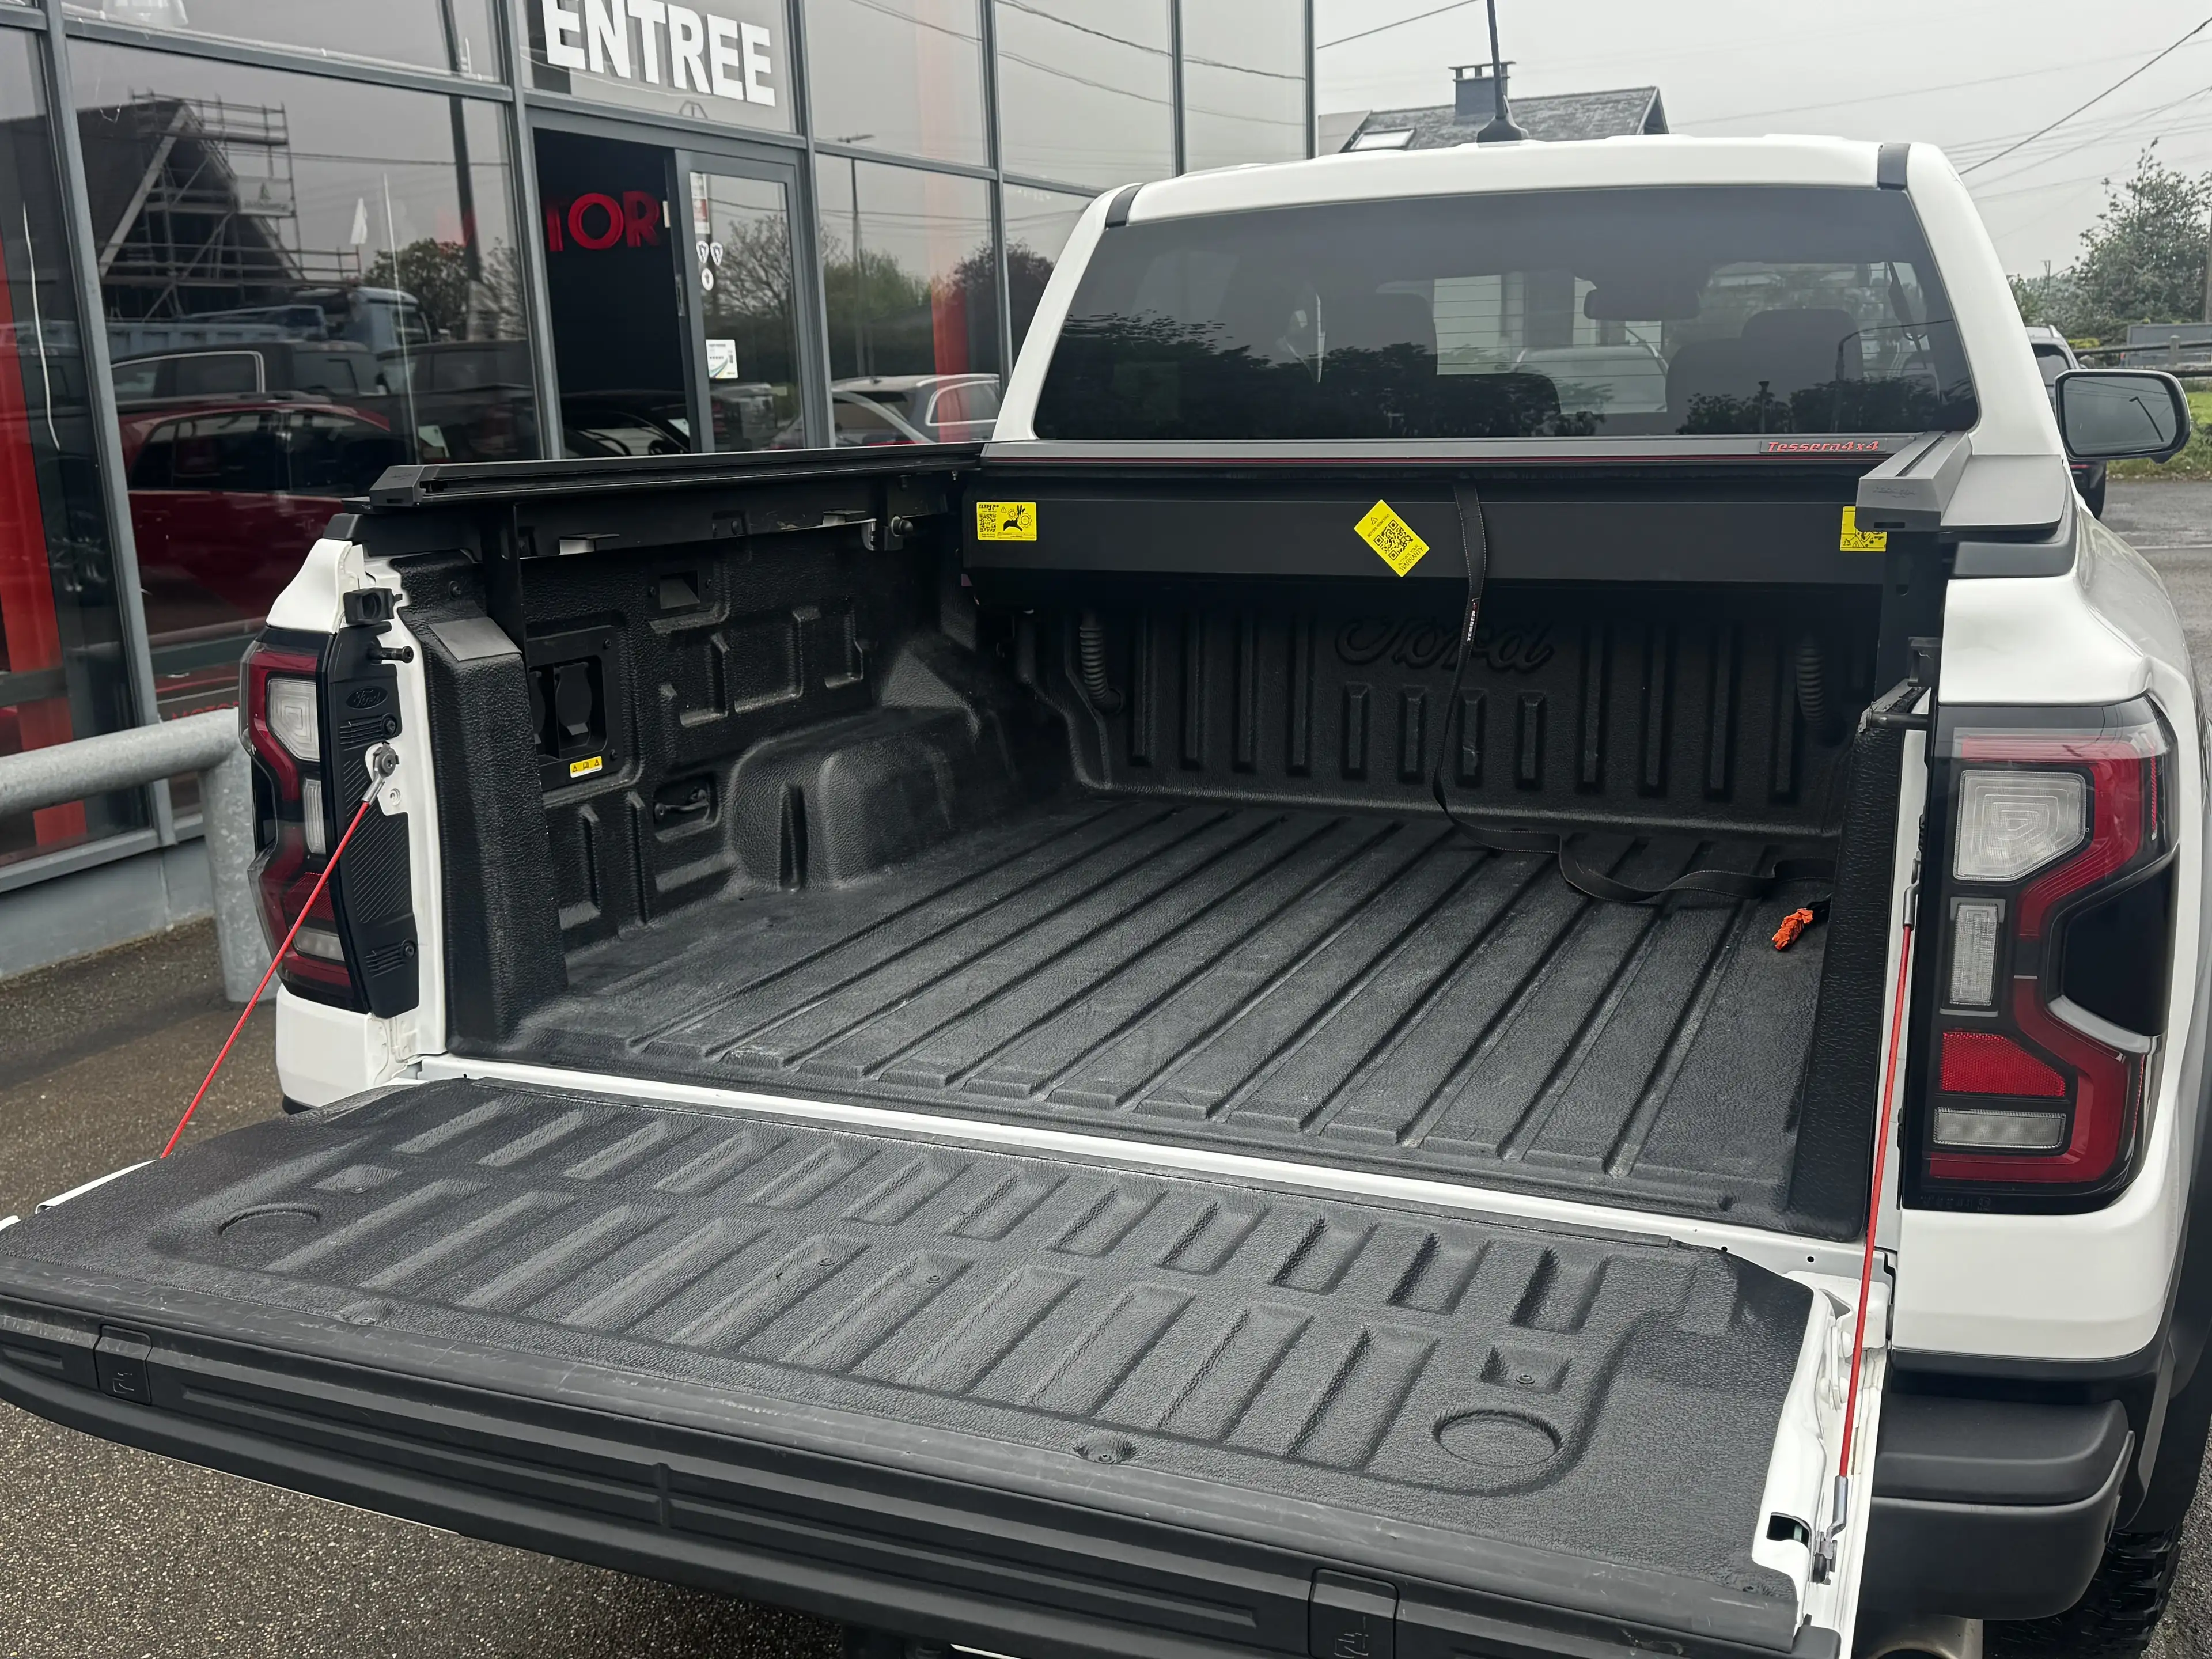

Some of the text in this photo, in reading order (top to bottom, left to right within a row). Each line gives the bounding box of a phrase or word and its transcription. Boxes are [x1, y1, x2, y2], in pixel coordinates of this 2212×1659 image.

[542, 0, 775, 107] ENTREE
[1399, 546, 1423, 571] WARRANTY
[353, 688, 382, 707] Ford
